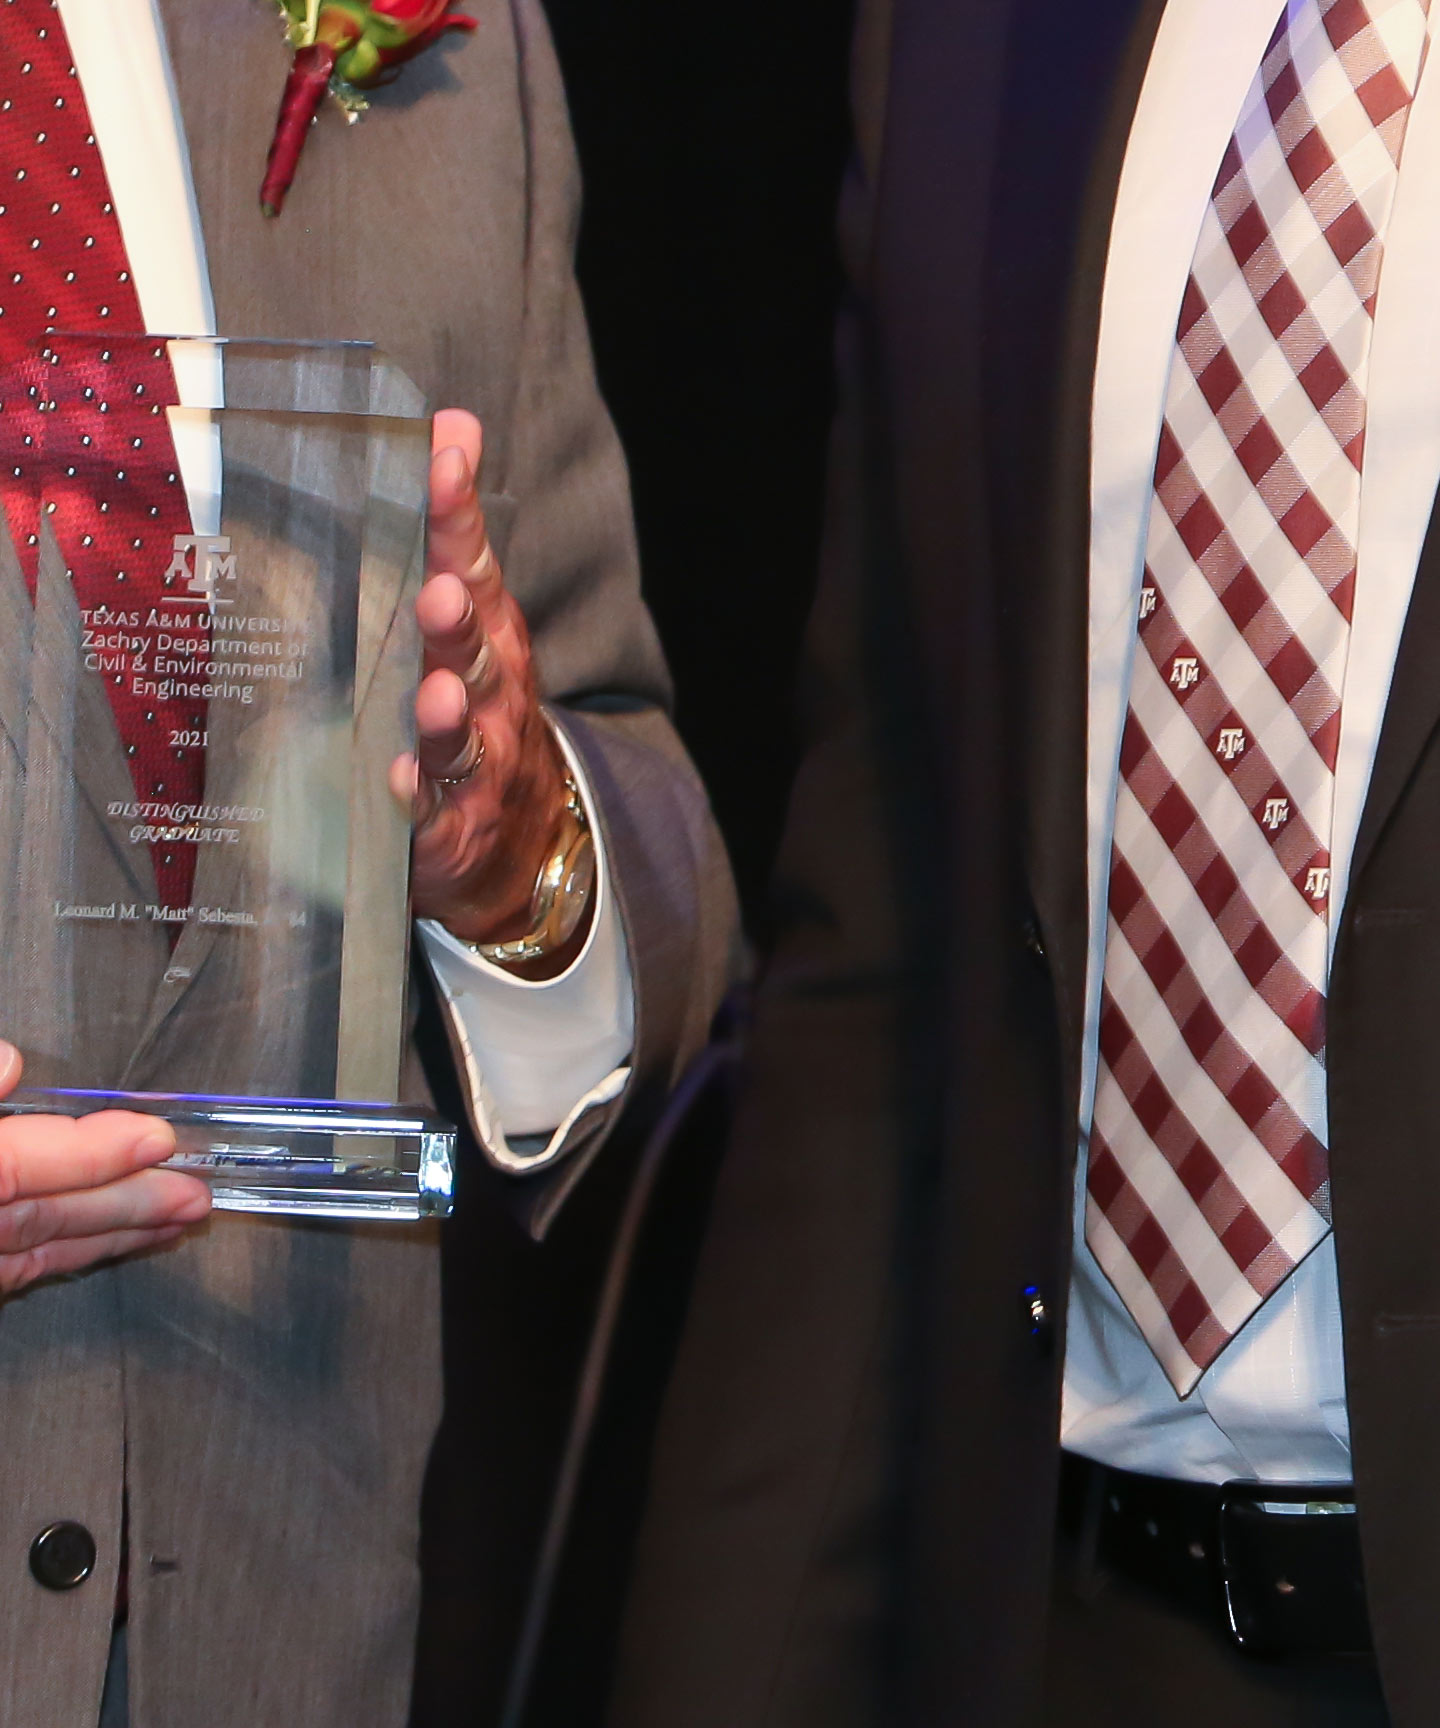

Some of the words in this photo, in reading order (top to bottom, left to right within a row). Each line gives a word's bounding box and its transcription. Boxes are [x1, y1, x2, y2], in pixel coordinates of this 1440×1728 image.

[80, 609, 140, 627] TEXAS
[145, 611, 192, 629] A&M
[81, 630, 151, 655] Zachry
[157, 633, 282, 656] Department
[84, 652, 126, 672] Civil
[131, 654, 147, 672] &
[154, 655, 304, 679] Environmental
[132, 677, 255, 704] Engineering
[168, 729, 210, 749] 2021
[107, 800, 266, 823] DISTINGUISHED
[129, 824, 241, 844] GRADUATE
[53, 900, 116, 919] Leonard
[120, 903, 140, 920] M.
[145, 903, 195, 922] "Matt"
